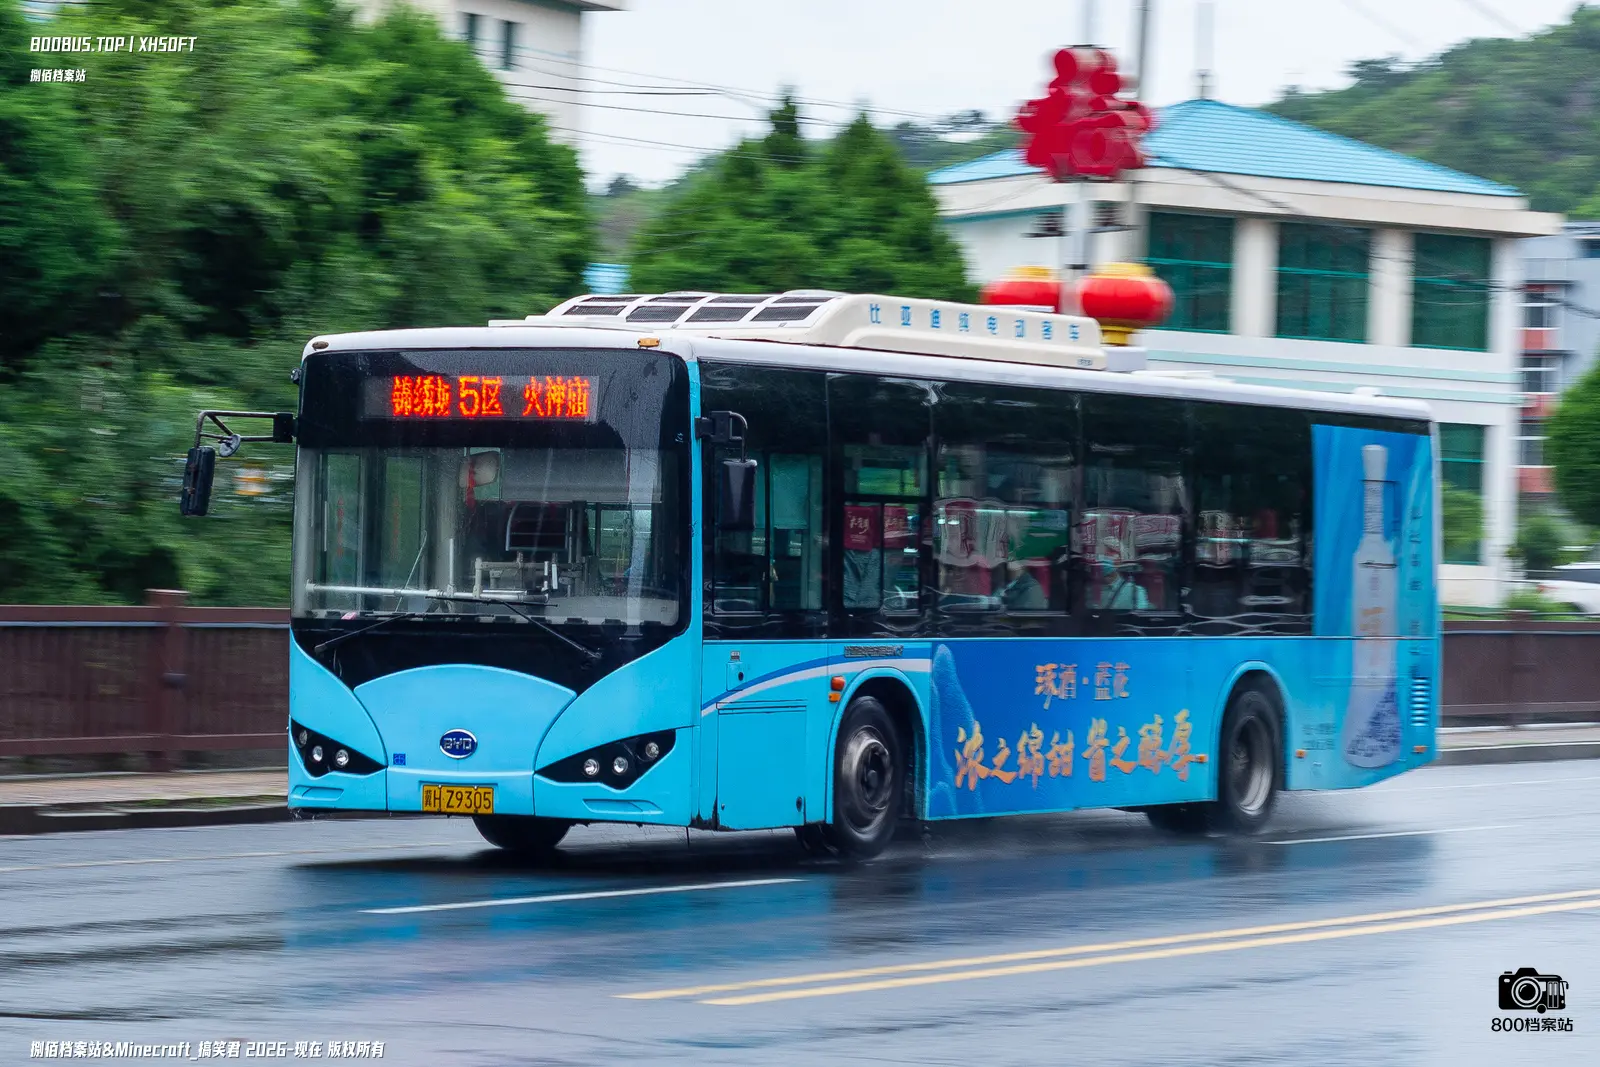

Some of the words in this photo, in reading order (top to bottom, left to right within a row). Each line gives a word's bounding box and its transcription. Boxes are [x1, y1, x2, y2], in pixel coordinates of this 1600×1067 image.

[457, 375, 504, 417] 5区
[522, 375, 591, 418] 火神庙
[443, 737, 473, 751] BYD
